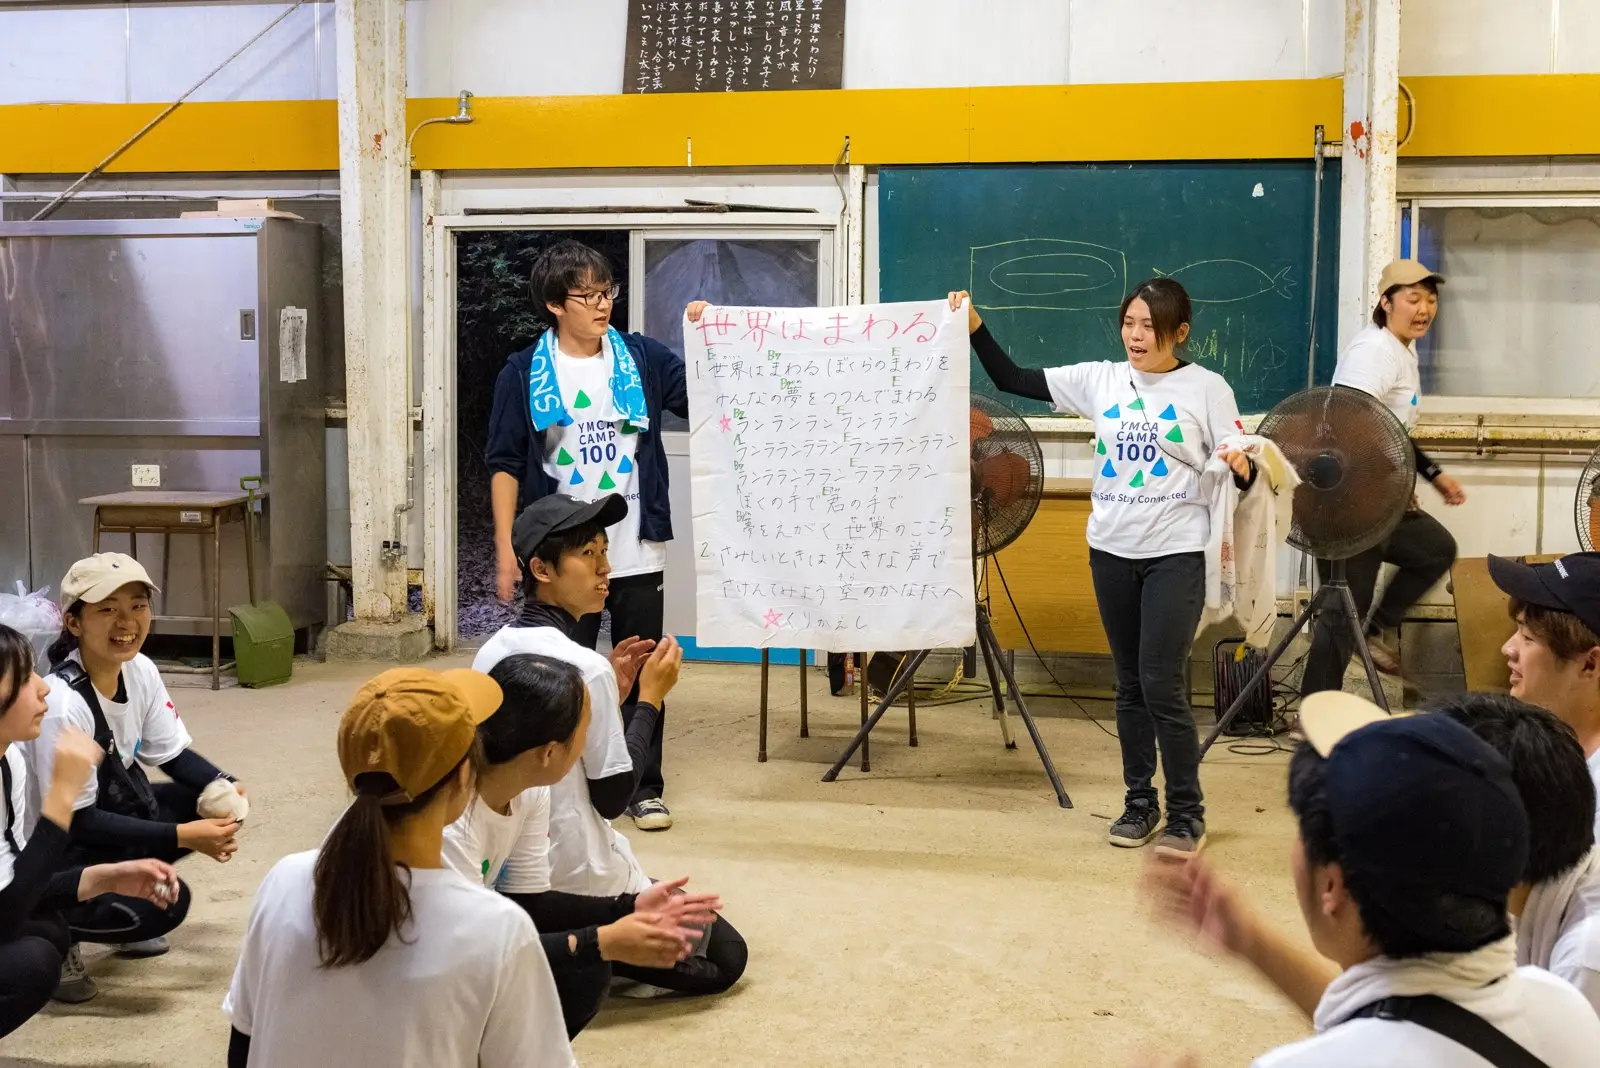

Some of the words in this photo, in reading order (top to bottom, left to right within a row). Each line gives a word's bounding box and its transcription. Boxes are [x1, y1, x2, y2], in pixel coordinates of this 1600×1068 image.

[696, 311, 937, 352] 世界はまわる
[578, 420, 615, 433] YMCA
[1121, 421, 1158, 432] YMCA
[579, 431, 615, 445] CAMP
[1117, 431, 1157, 443] CAMP
[580, 443, 616, 465] 100
[1116, 443, 1156, 462] 100
